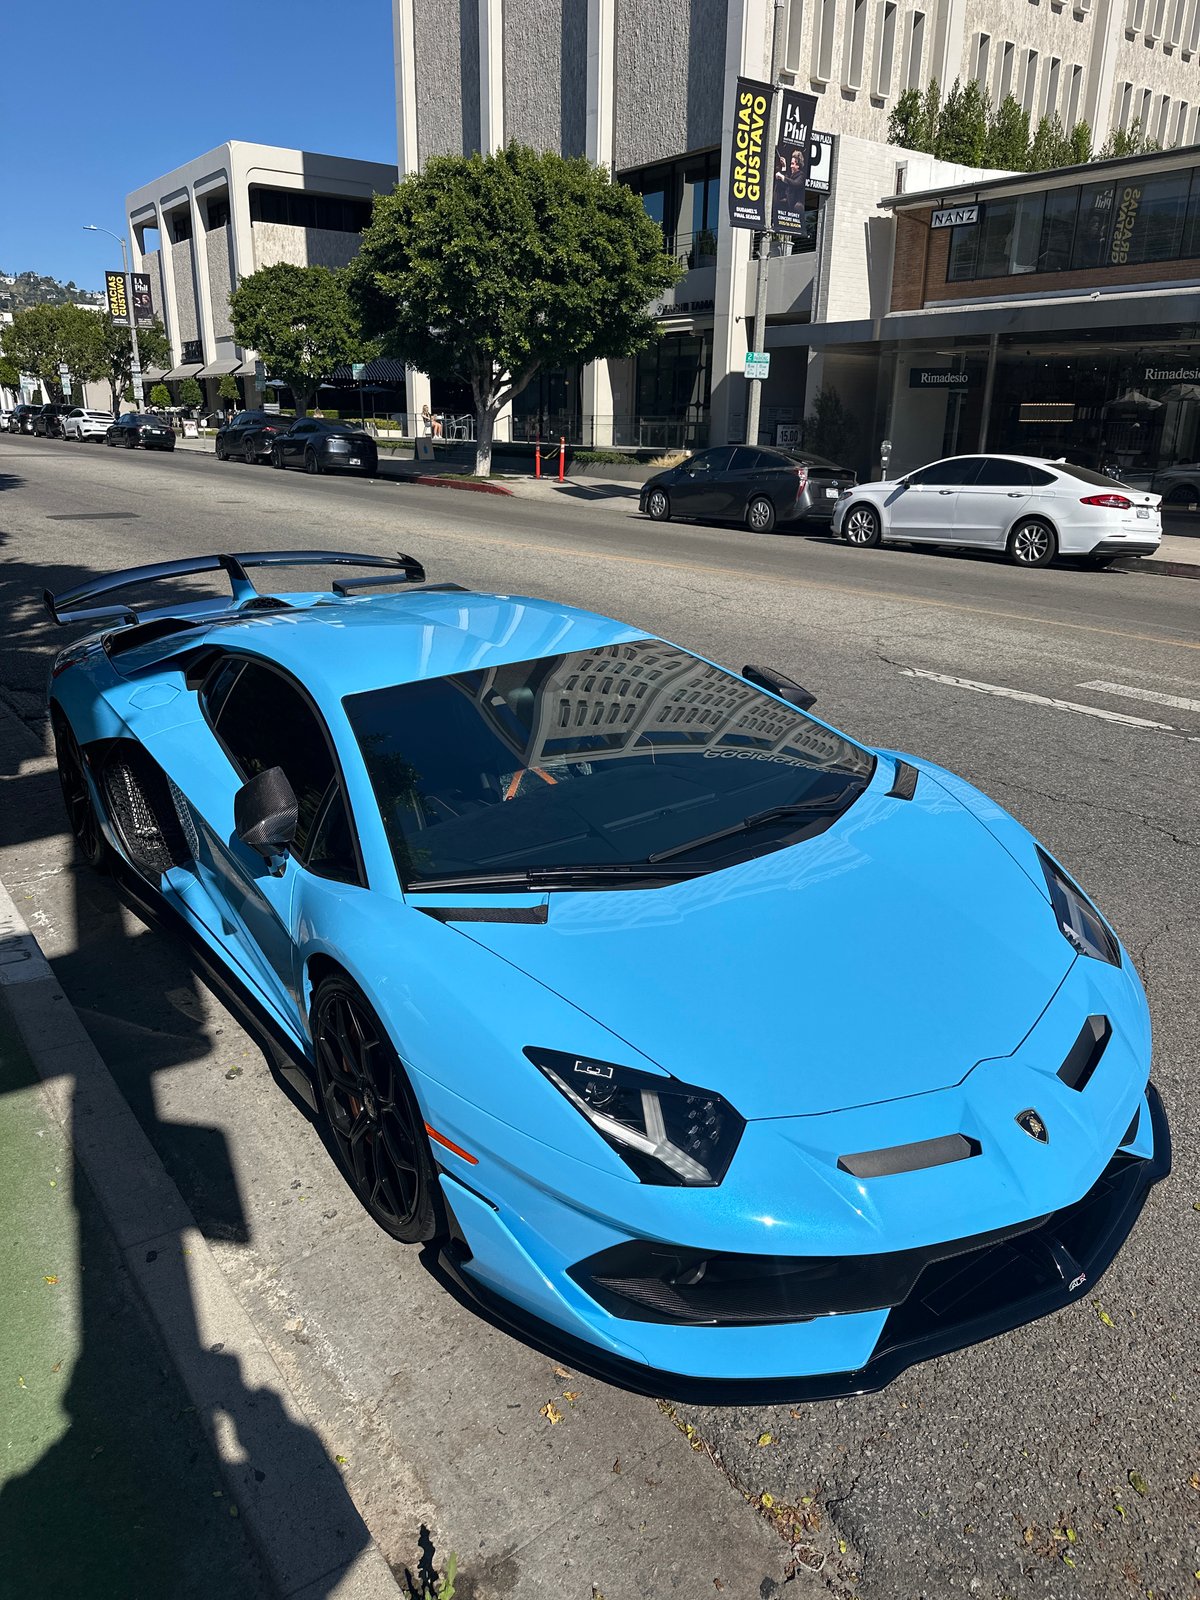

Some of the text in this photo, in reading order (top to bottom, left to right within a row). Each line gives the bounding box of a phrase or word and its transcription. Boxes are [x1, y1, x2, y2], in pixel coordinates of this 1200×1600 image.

[786, 104, 800, 122] LA
[783, 121, 807, 141] Phil
[820, 134, 832, 144] PLAZA
[733, 92, 754, 199] GRACIAS
[747, 96, 767, 201] GUSTAVO
[810, 180, 829, 190] PARKING
[934, 209, 976, 225] NANZ
[134, 277, 143, 285] LA
[134, 284, 149, 292] Phil
[108, 275, 119, 316] GRACIAS
[116, 276, 127, 317] GUSTAVO
[920, 372, 969, 383] Rimadesio
